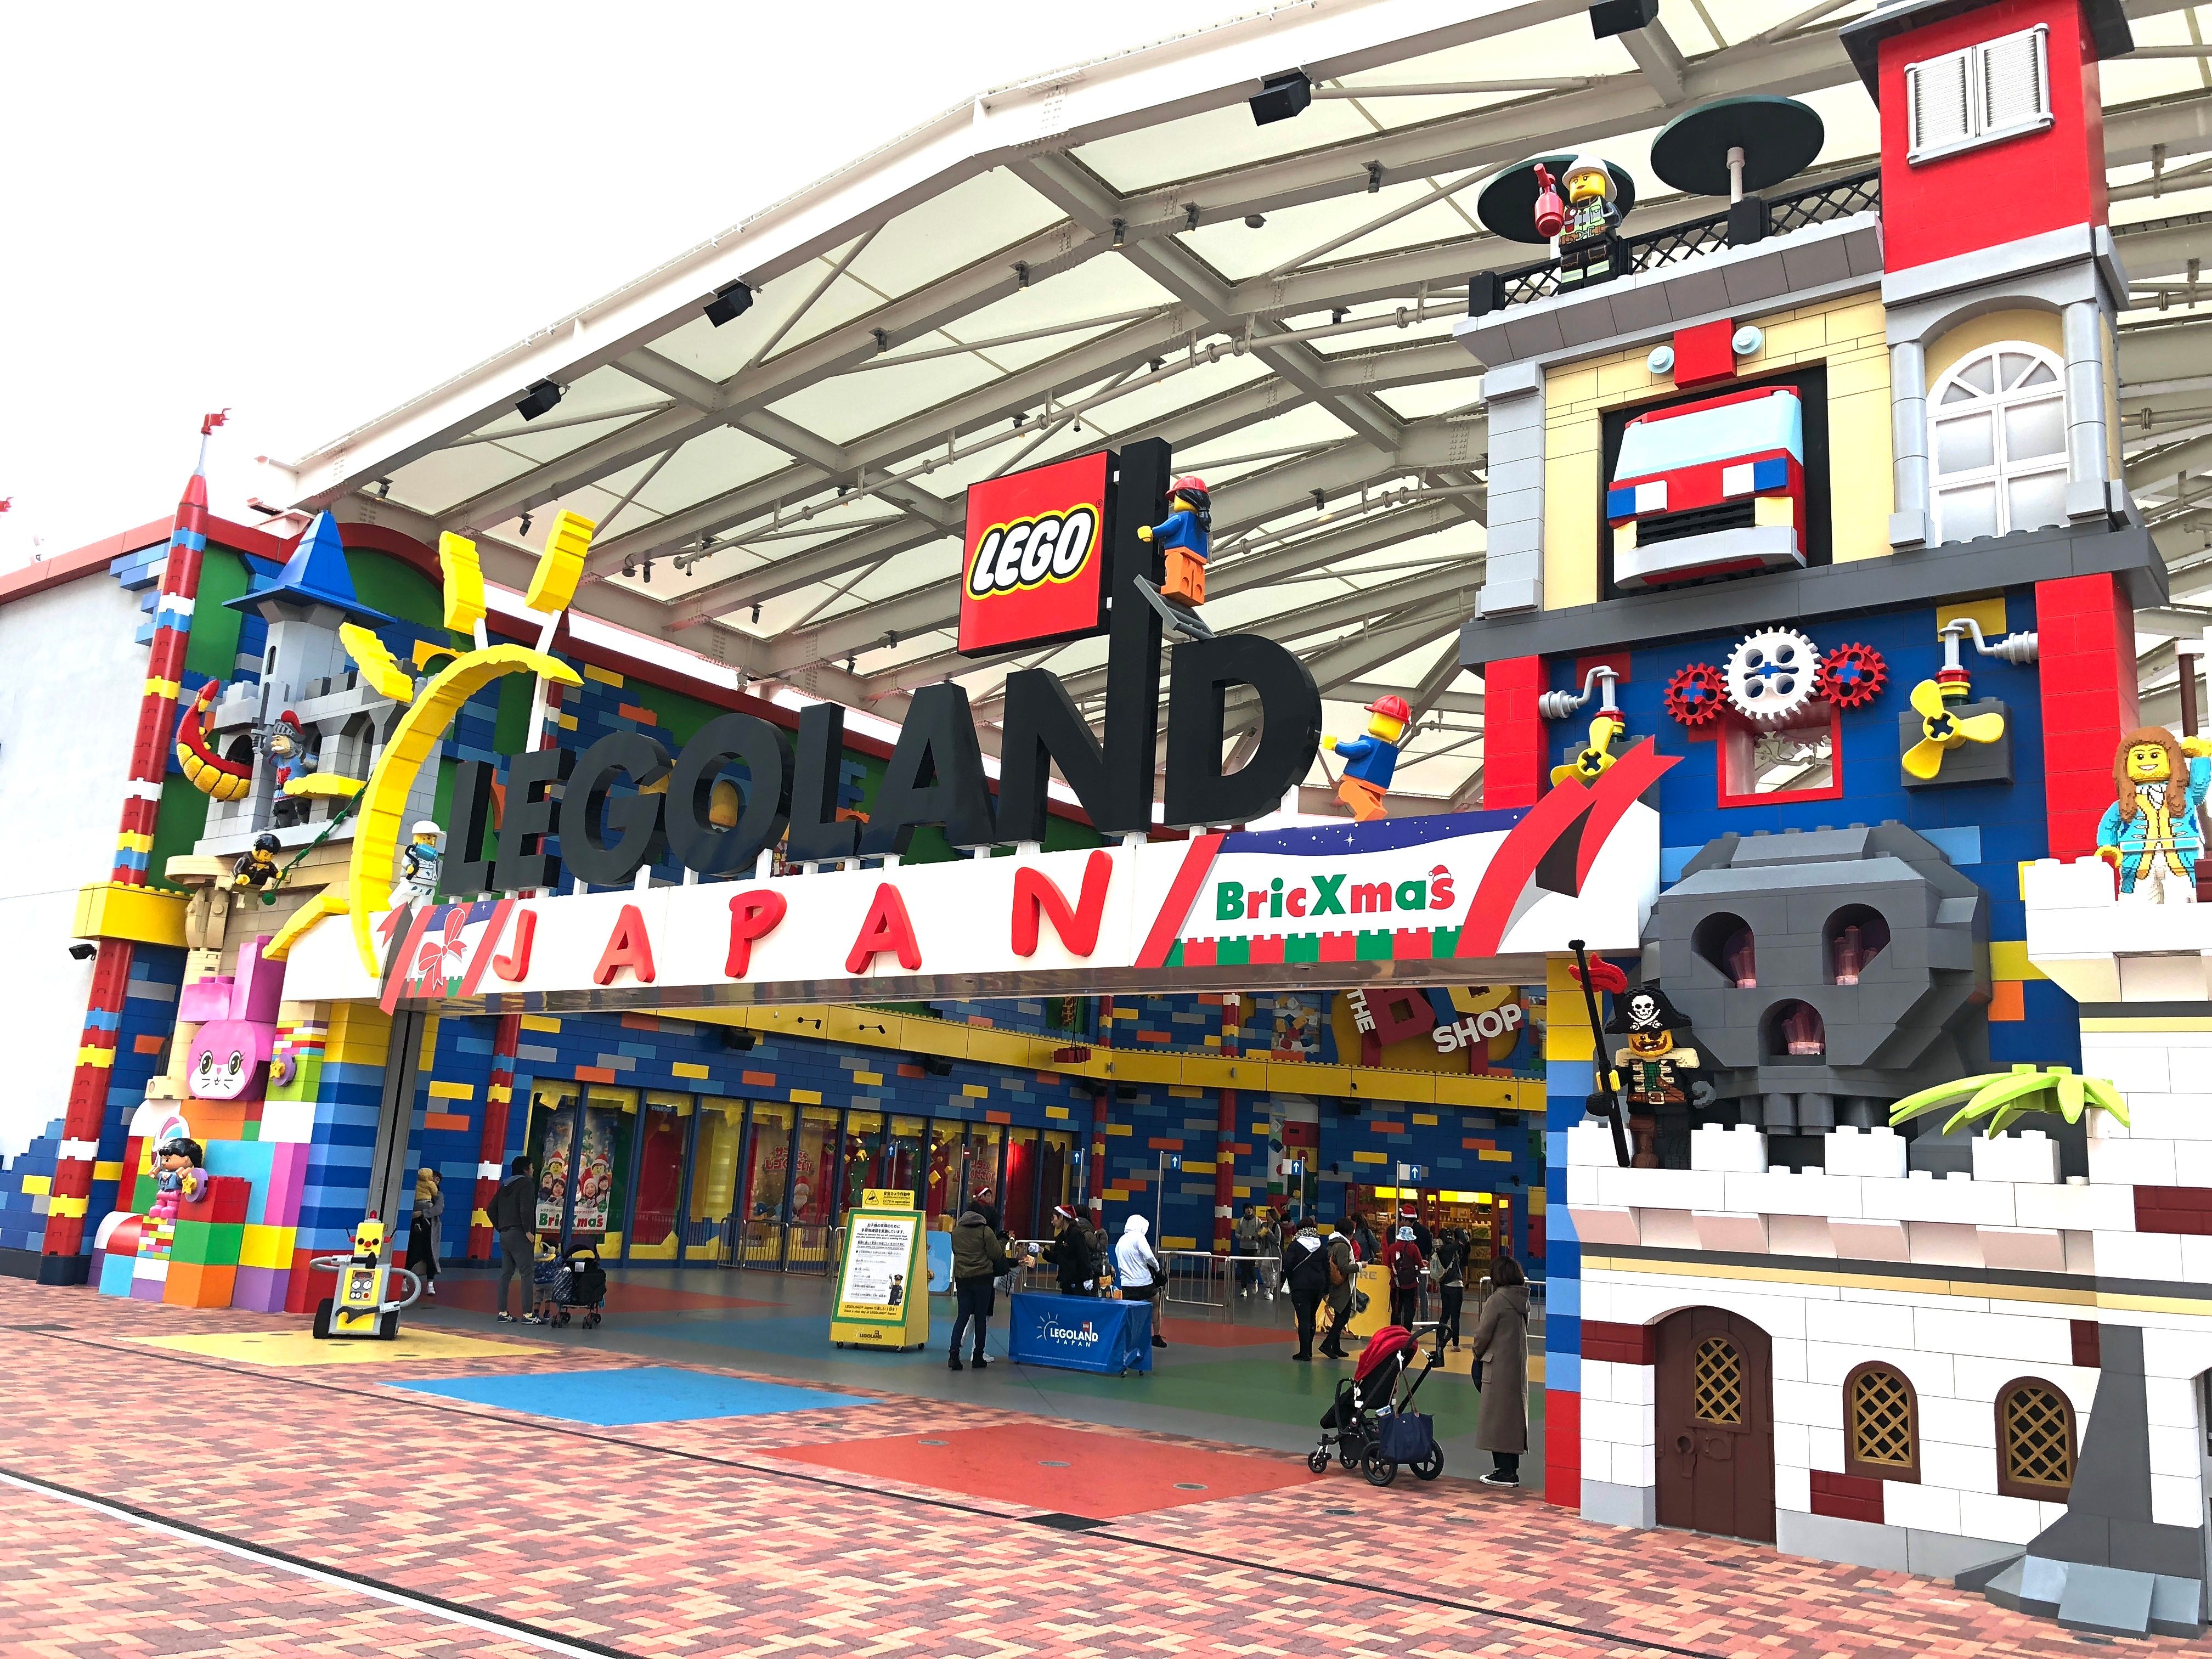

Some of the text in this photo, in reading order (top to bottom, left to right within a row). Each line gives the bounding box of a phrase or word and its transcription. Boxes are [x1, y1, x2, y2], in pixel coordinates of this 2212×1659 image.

[969, 506, 1096, 597] LEGO
[439, 437, 1322, 897] LEGOLAND
[492, 849, 1113, 986] JAPAN
[1216, 866, 1455, 921] BricXmas
[1346, 989, 1375, 1034] THE
[1432, 1003, 1522, 1053] SHOP
[1050, 1322, 1098, 1342] LEGOLAND
[1056, 1339, 1091, 1347] JAPAN
